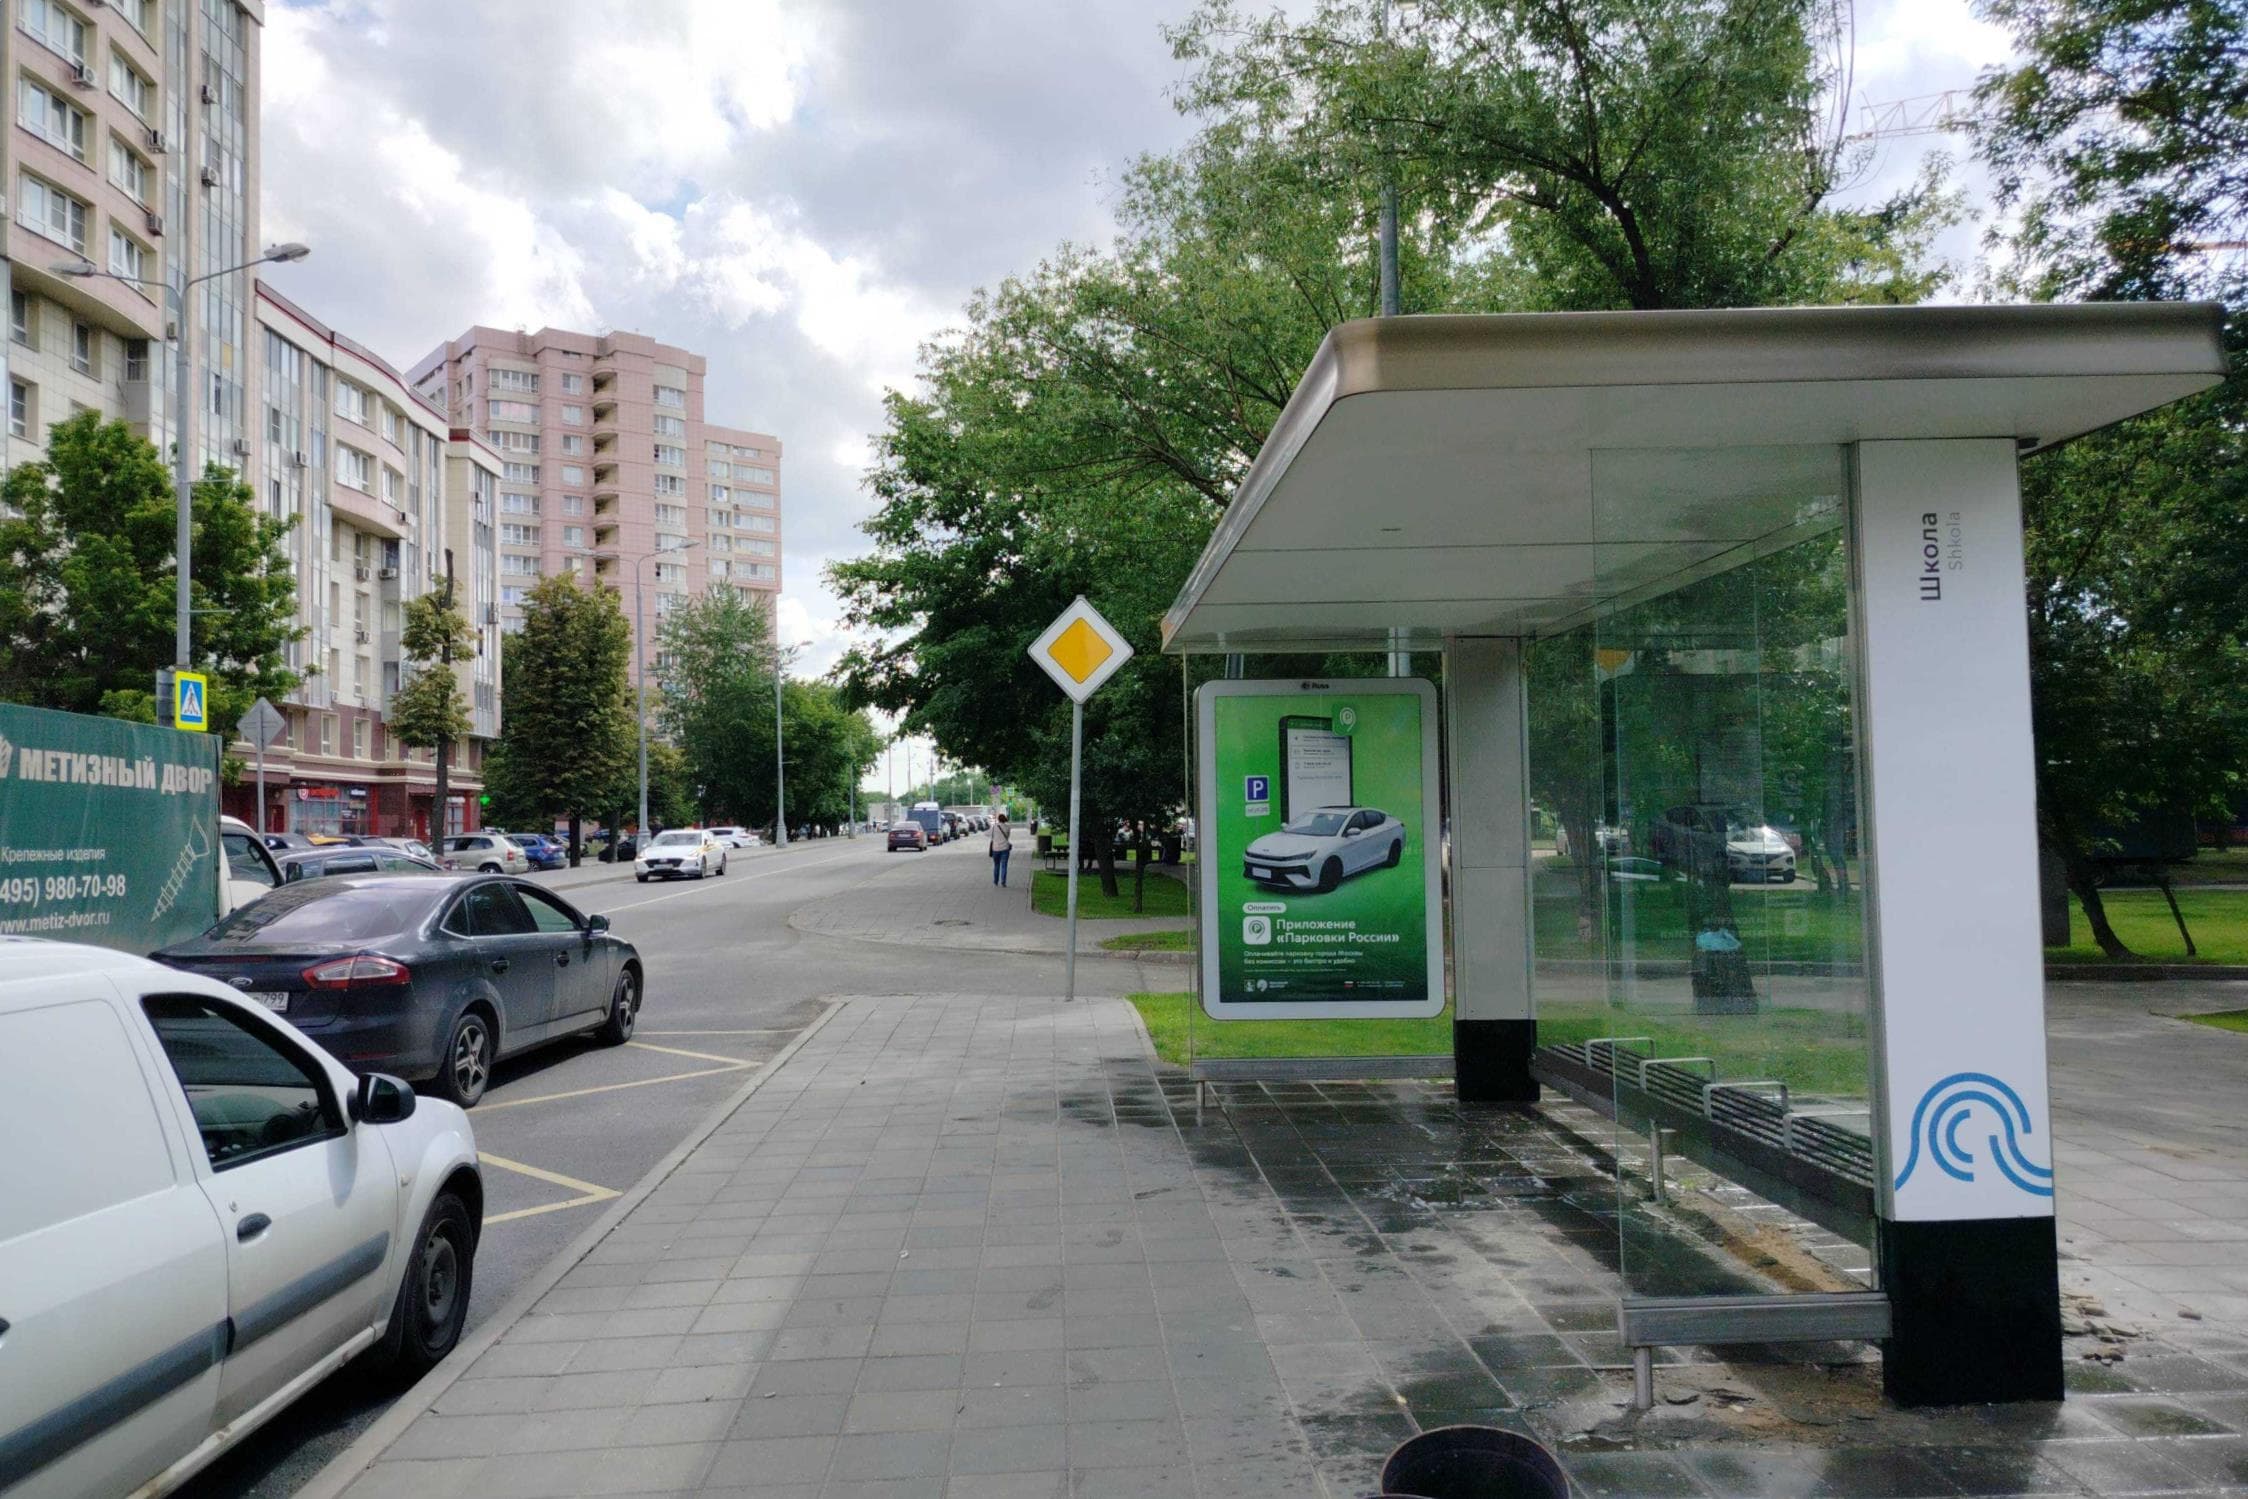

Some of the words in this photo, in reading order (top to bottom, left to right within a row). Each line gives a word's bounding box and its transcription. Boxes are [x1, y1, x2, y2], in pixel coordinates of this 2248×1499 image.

[1946, 512, 1962, 570] Shkola
[1919, 512, 1941, 600] Школа
[19, 748, 157, 790] МЕТИЗНЫЙ
[160, 763, 213, 795] ДВОР
[1, 847, 64, 865] Крепежные
[66, 849, 106, 863] изделия
[45, 874, 126, 900] 980-70-98
[1276, 919, 1356, 931] Приложение
[1276, 932, 1346, 945] «Парковки
[1349, 932, 1400, 944] России»
